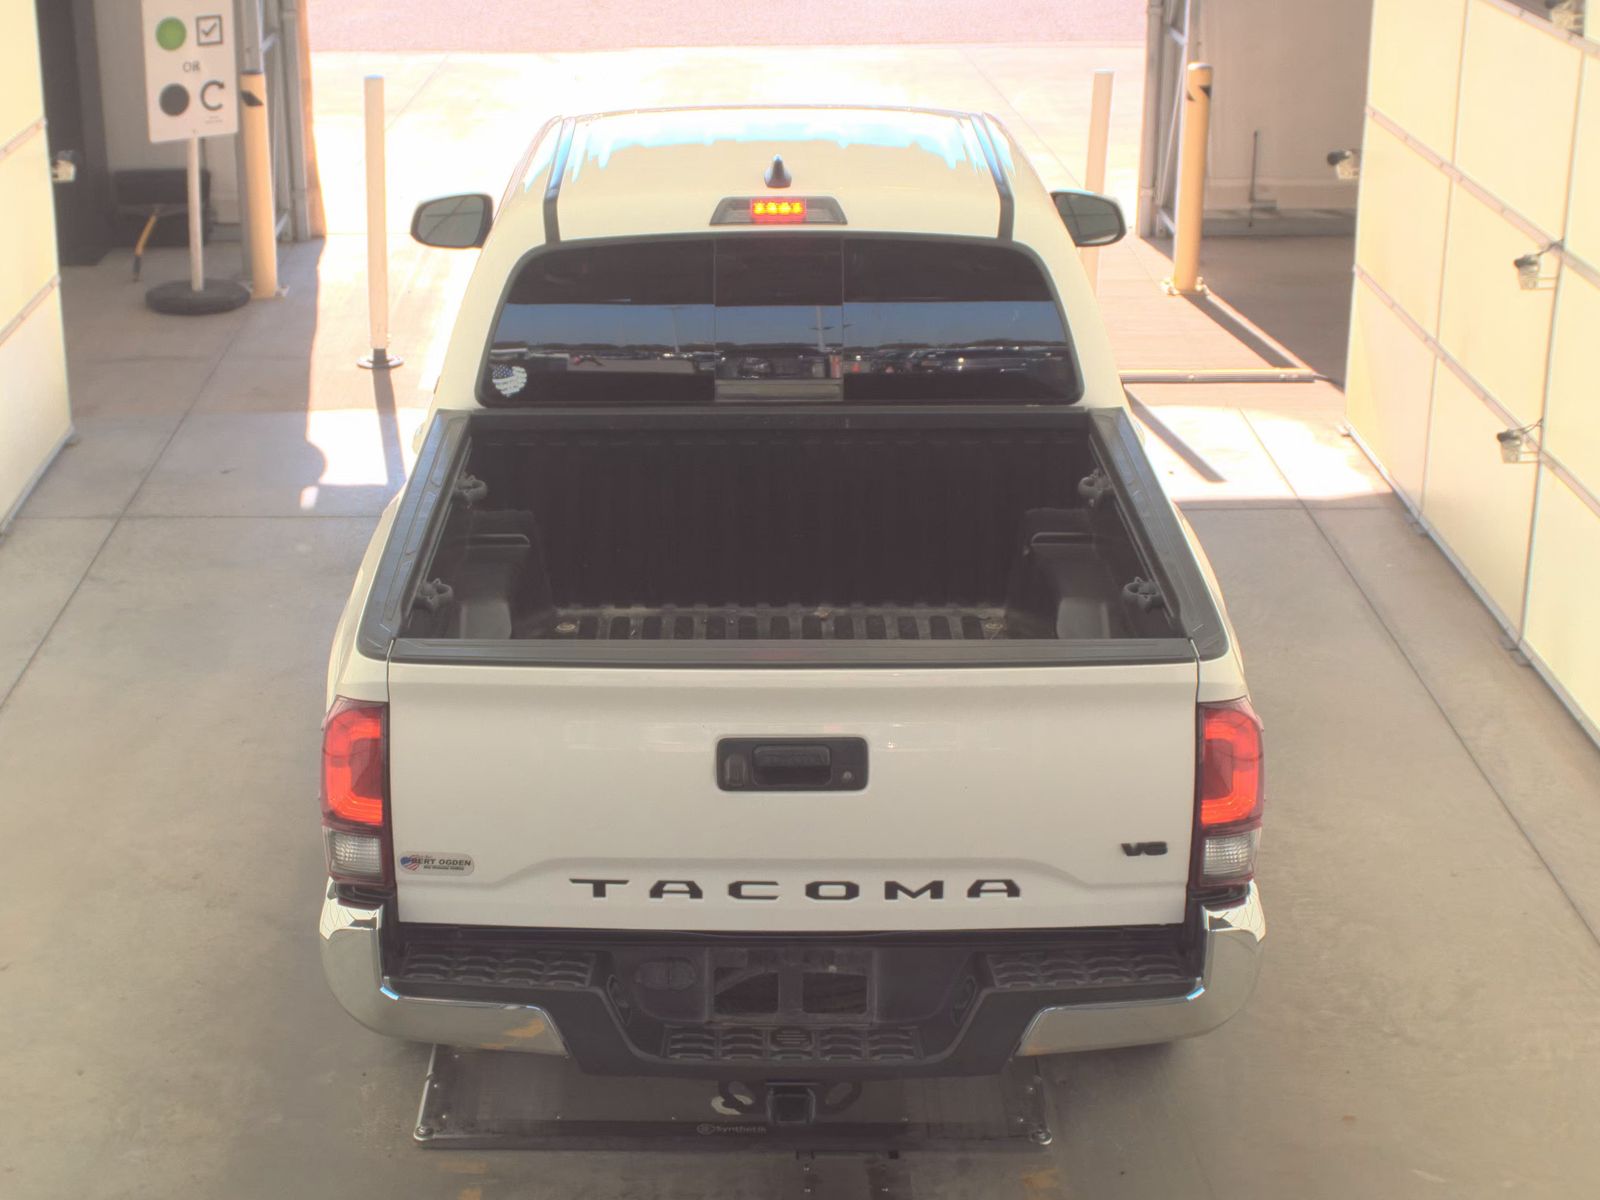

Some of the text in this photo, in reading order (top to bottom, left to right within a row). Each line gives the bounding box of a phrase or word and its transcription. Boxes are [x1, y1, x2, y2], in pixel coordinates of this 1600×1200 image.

[182, 61, 201, 73] OR
[1121, 841, 1169, 856] V6
[568, 877, 1021, 900] TACOMA
